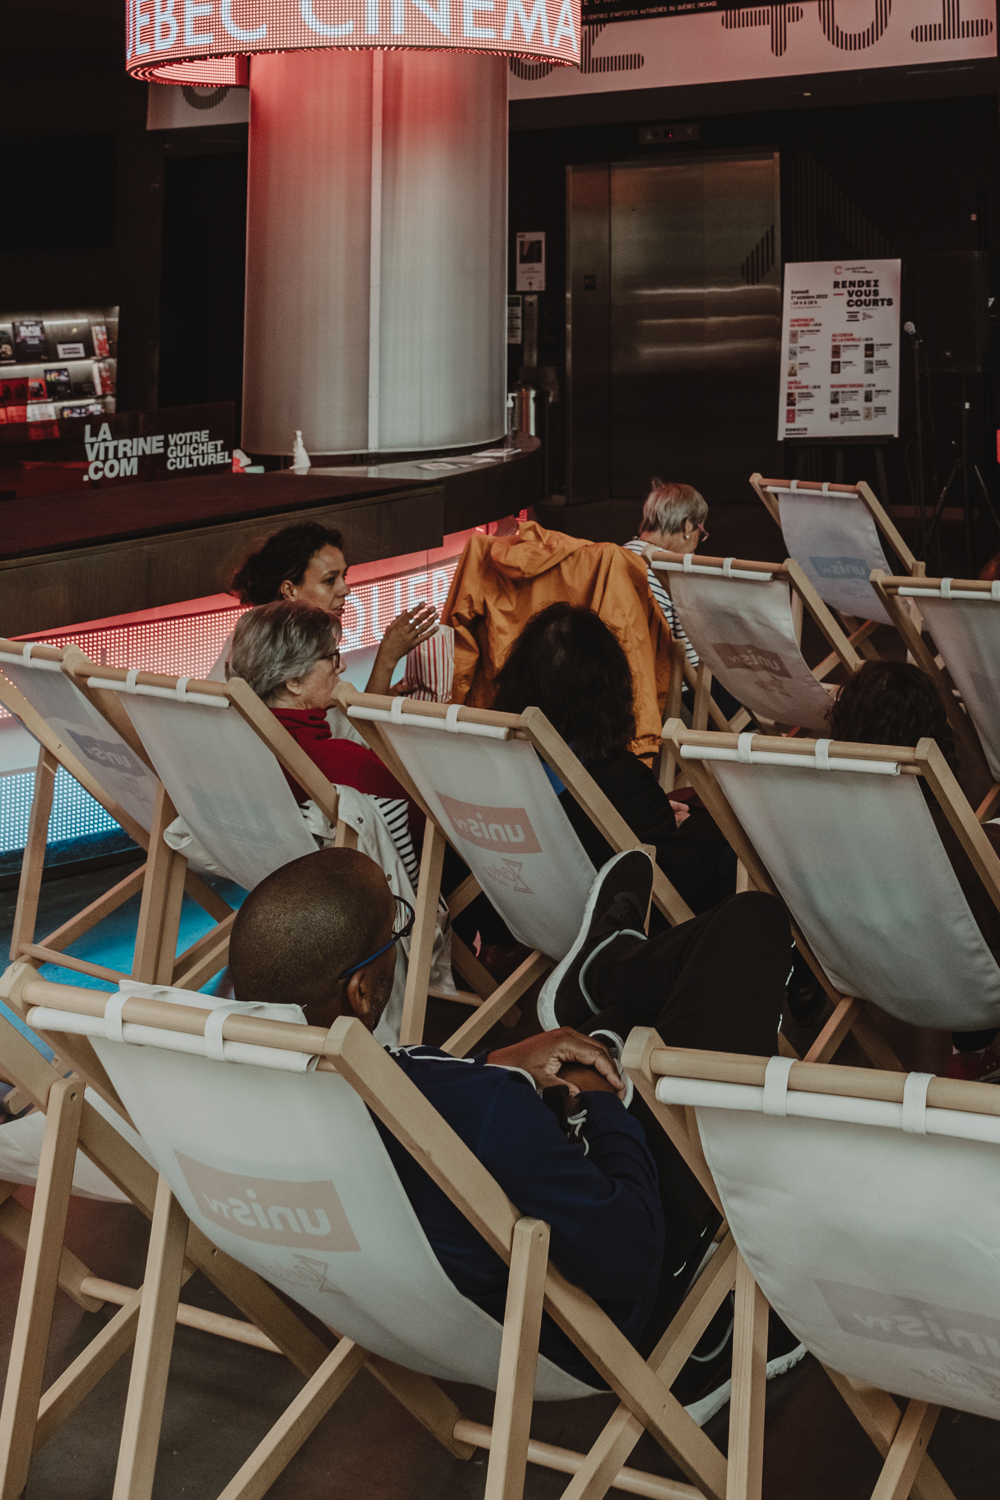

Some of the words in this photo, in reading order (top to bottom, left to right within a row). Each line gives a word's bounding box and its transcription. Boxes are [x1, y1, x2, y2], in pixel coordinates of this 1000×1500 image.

[833, 279, 879, 289] RENDEZ
[846, 289, 879, 298] VOUS
[846, 298, 894, 308] COURTS
[84, 422, 112, 443] LA
[168, 430, 209, 445] VOTRE
[85, 435, 164, 462] VITRINE
[167, 440, 224, 458] GUICHET
[83, 457, 138, 481] .COM
[167, 451, 232, 470] CULTUREL
